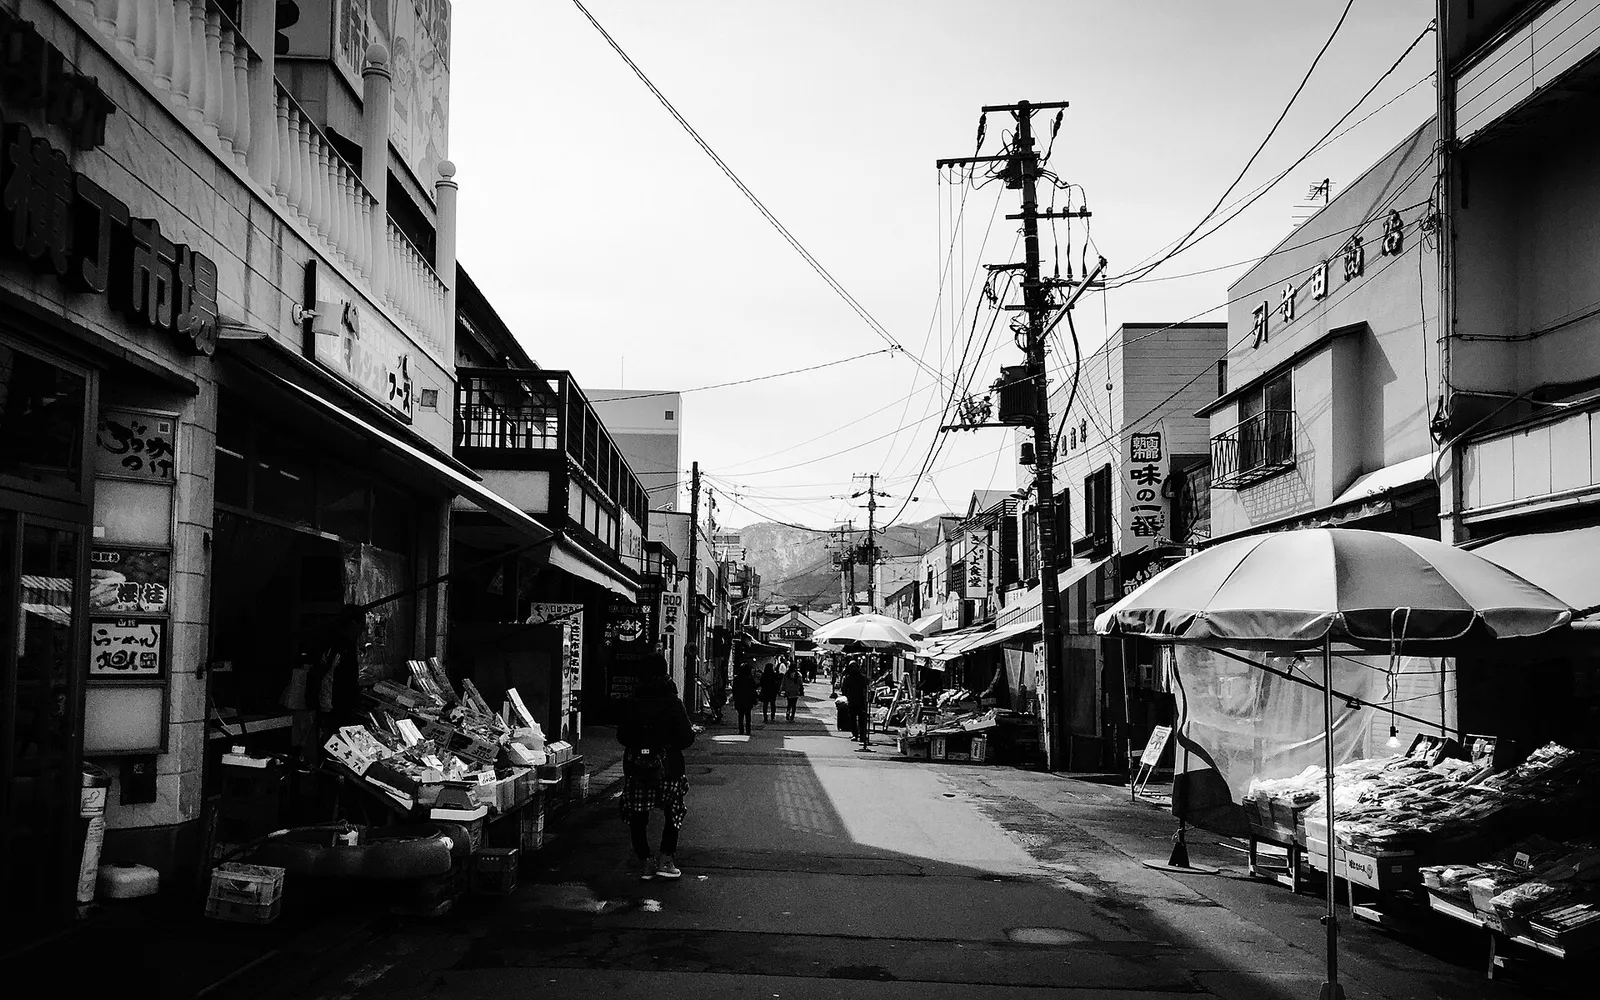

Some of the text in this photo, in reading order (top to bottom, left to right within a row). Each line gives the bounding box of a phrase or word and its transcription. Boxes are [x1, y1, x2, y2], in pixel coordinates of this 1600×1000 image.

[4, 124, 217, 356] 横丁市場
[1130, 464, 1162, 537] 味の一番
[93, 626, 158, 647] らーめん
[471, 749, 492, 760] メロン
